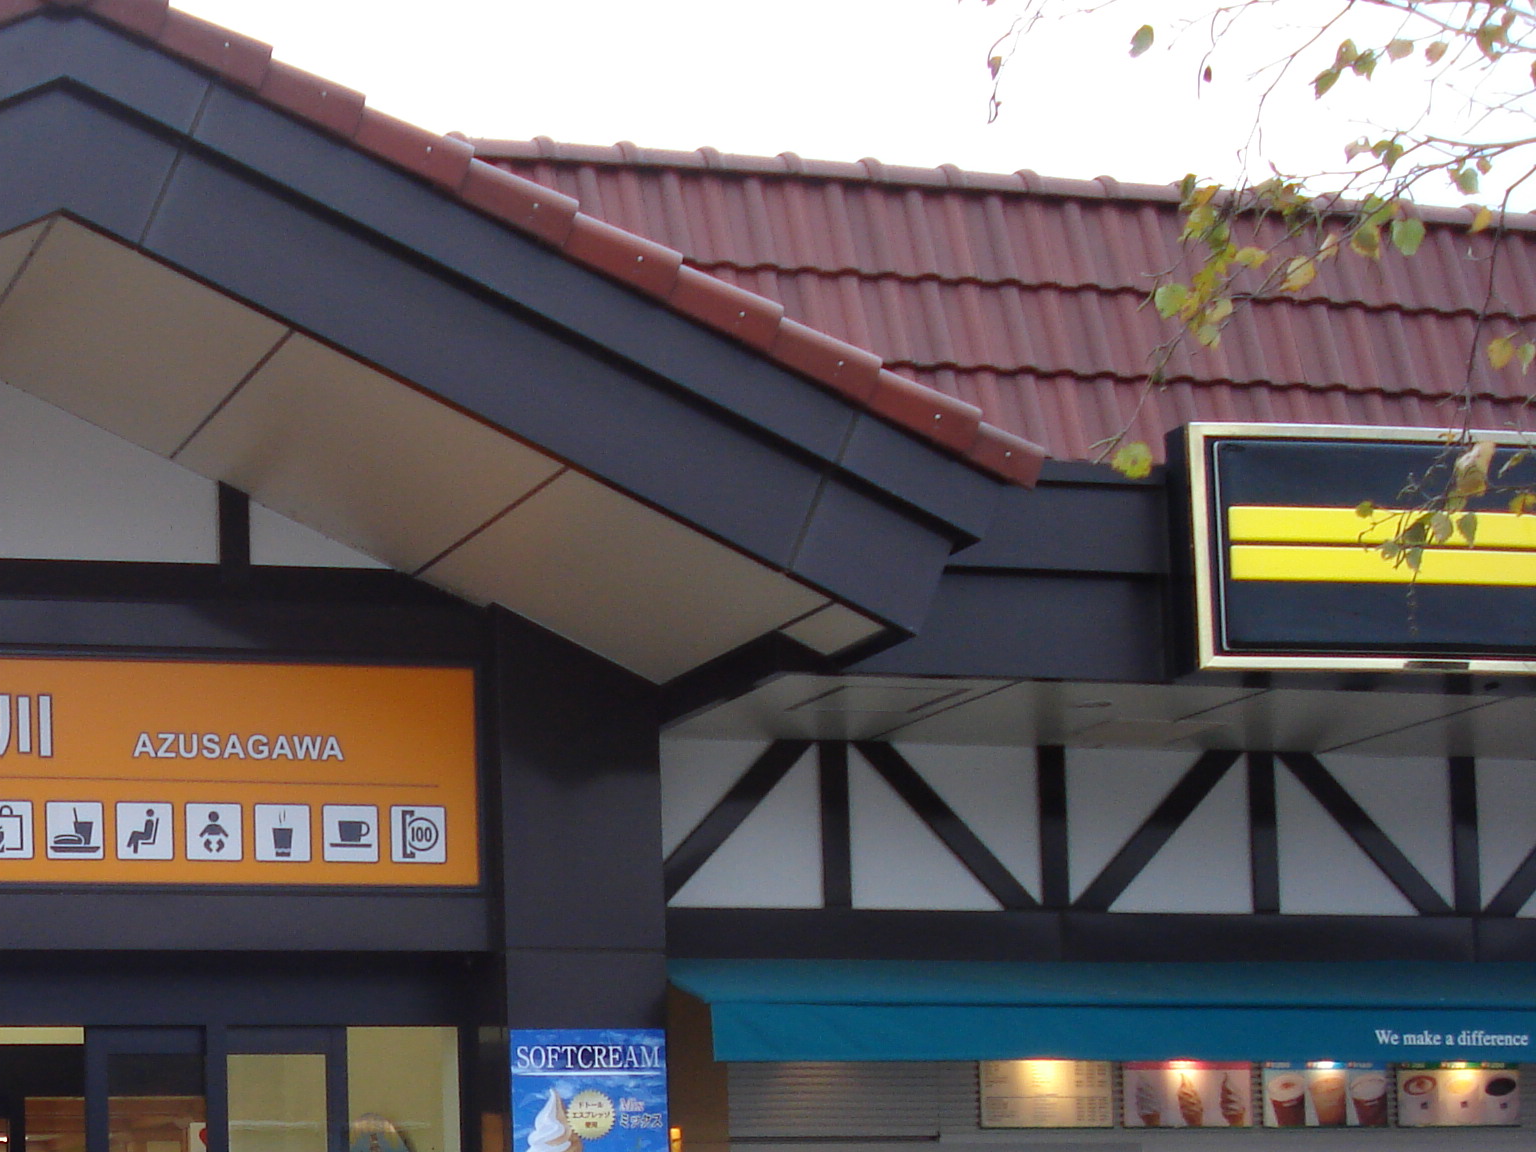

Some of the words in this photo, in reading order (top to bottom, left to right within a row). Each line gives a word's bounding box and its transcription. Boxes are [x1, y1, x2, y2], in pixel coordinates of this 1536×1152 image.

[133, 731, 345, 762] AZUSAGAWA
[411, 826, 432, 842] 100
[1375, 1029, 1399, 1045] We
[1403, 1030, 1441, 1045] make
[1446, 1034, 1454, 1046] a
[1457, 1030, 1529, 1046] difference
[516, 1045, 661, 1069] SOFTCREAM
[619, 1113, 663, 1129] ミックス
